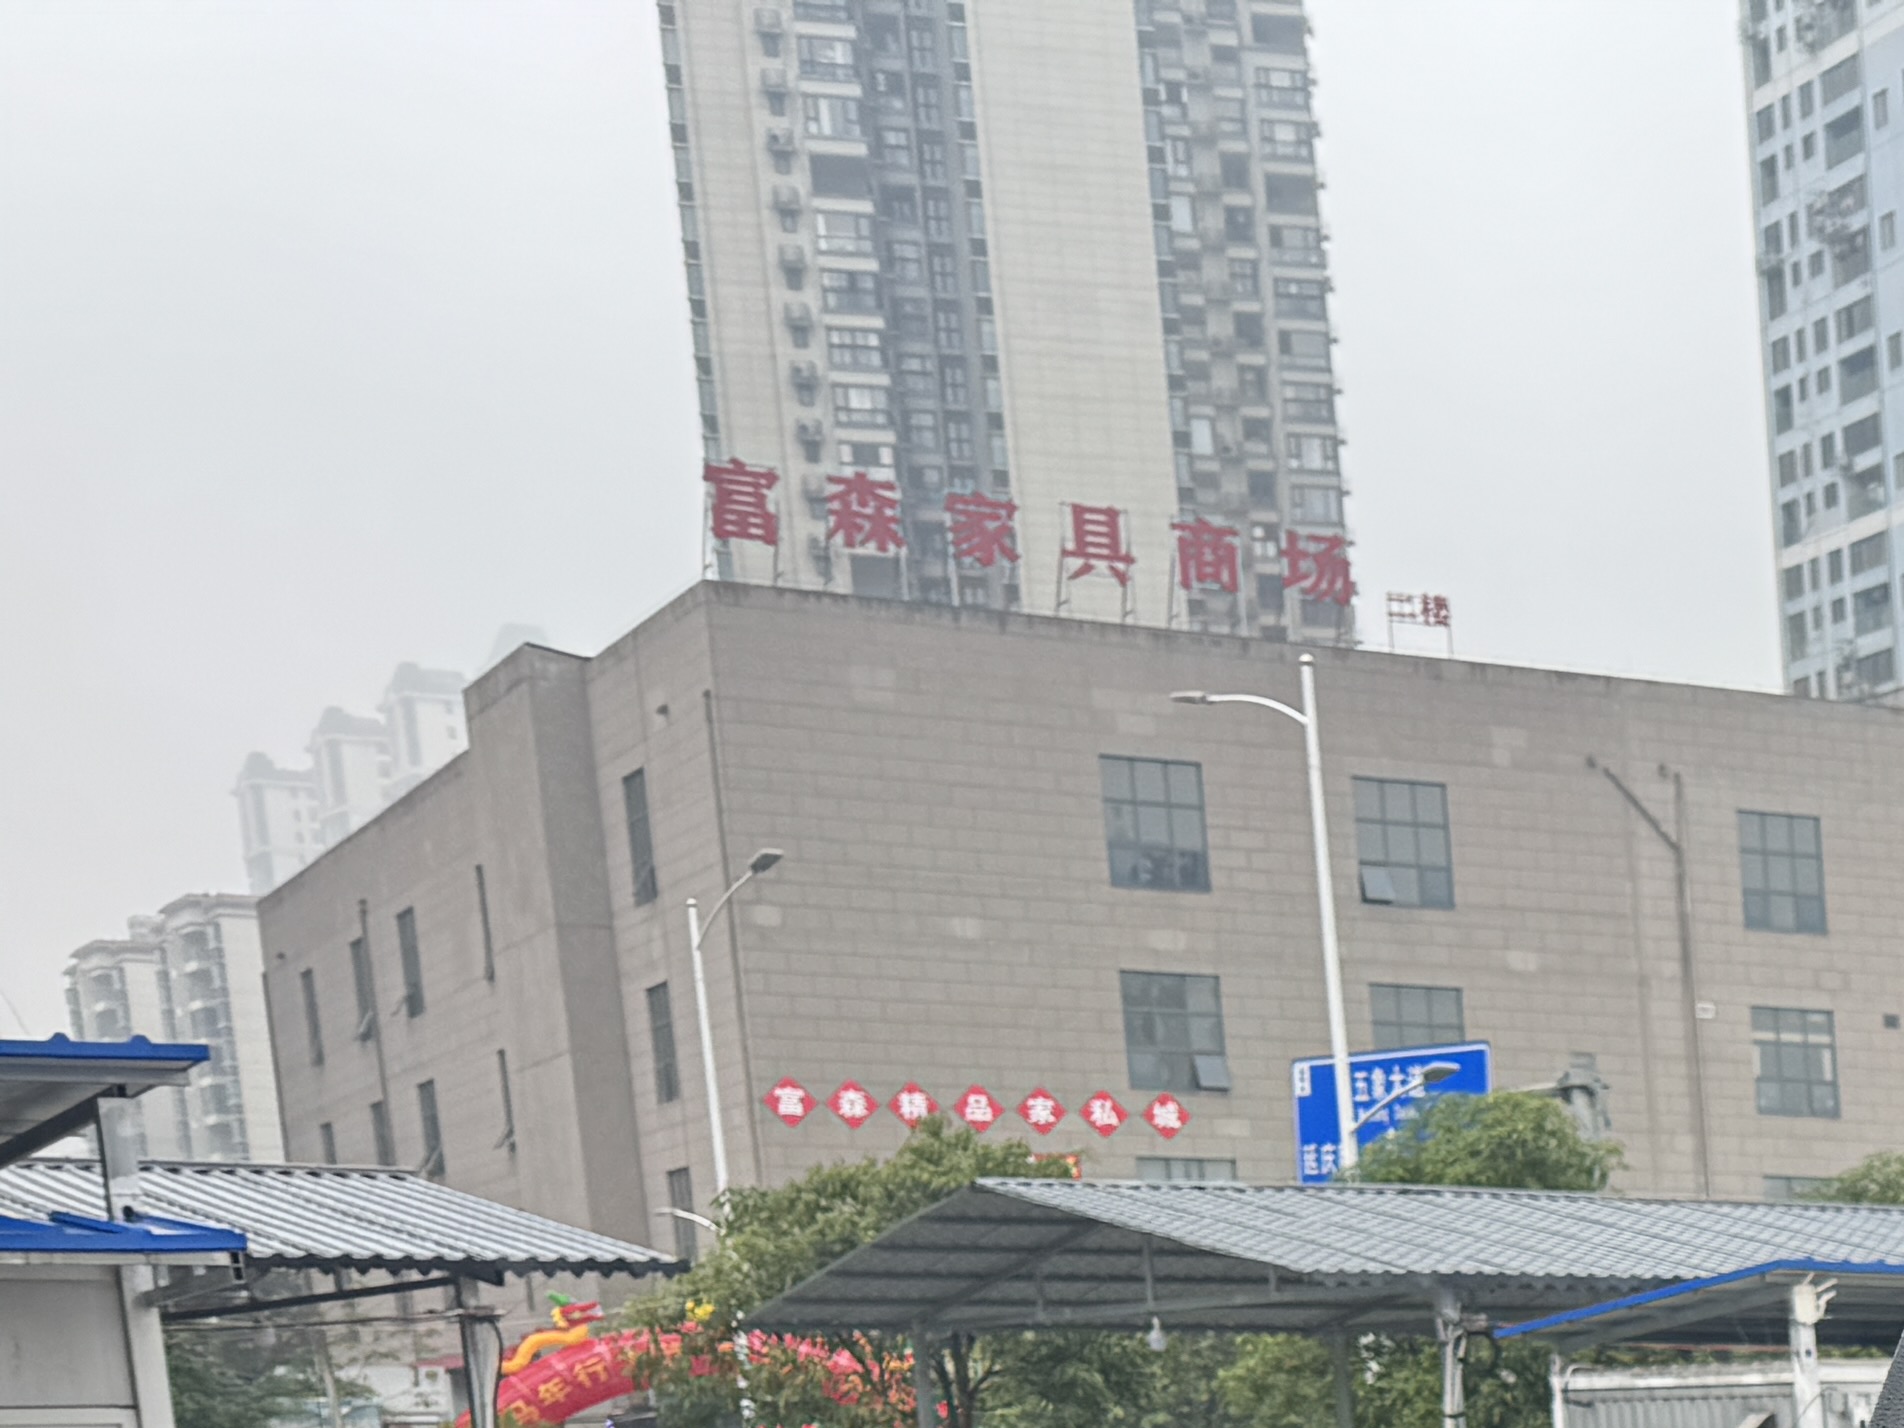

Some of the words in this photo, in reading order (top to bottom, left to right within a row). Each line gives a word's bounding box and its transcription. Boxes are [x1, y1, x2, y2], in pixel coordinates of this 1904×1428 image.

[702, 458, 1357, 606] 富森家具商场
[772, 1085, 1184, 1130] 富森精品家私城
